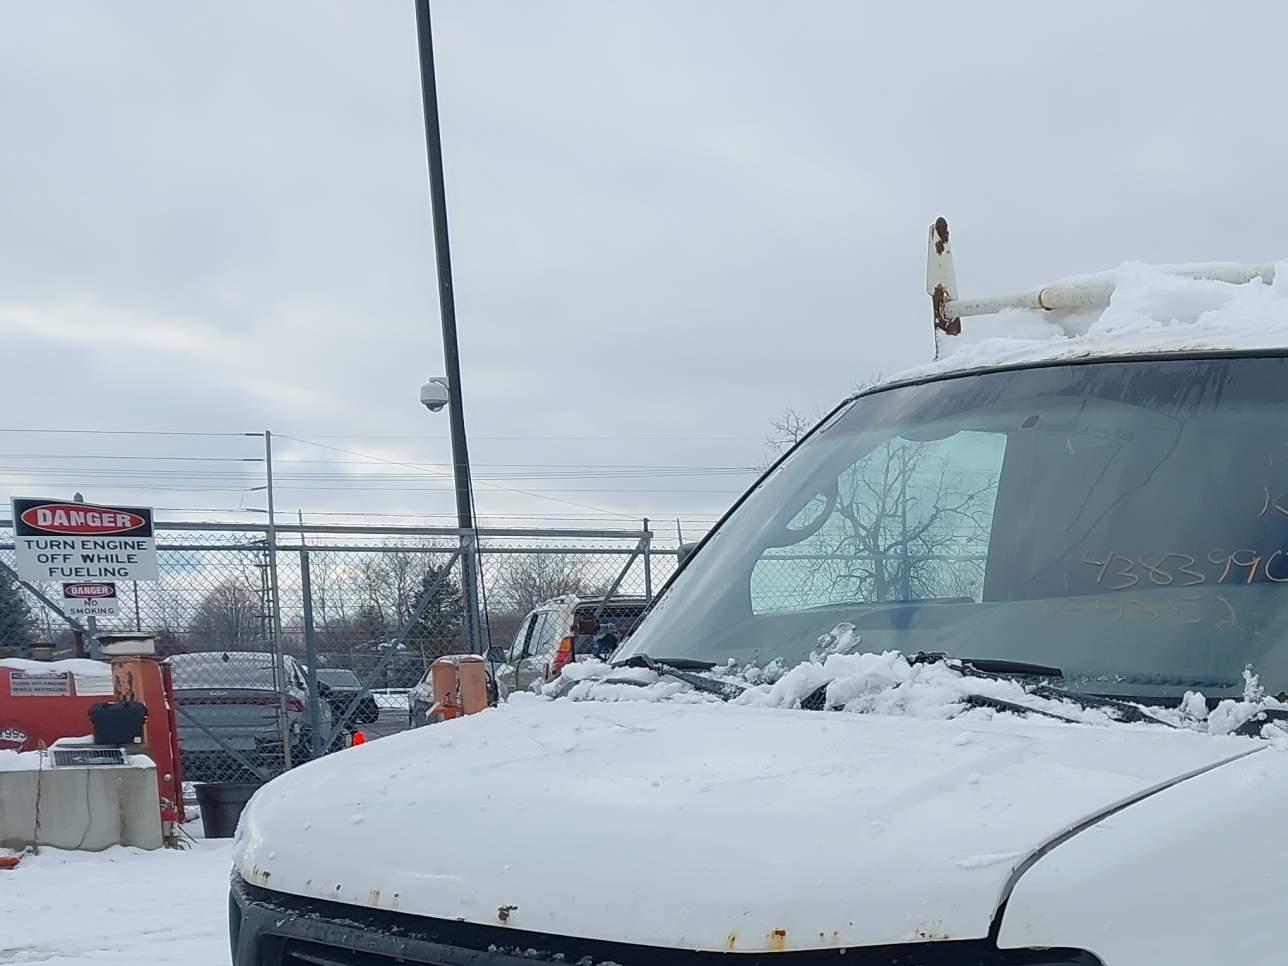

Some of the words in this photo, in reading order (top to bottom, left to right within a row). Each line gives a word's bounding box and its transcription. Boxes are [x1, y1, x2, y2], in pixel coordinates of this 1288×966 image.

[36, 508, 132, 528] DANGER
[24, 539, 75, 550] TURN
[81, 540, 148, 551] ENGINE
[37, 553, 73, 564] OFF
[80, 553, 138, 564] WHILE
[49, 567, 129, 578] FUELING
[71, 586, 109, 595] DANGER
[70, 607, 115, 615] SMOKING
